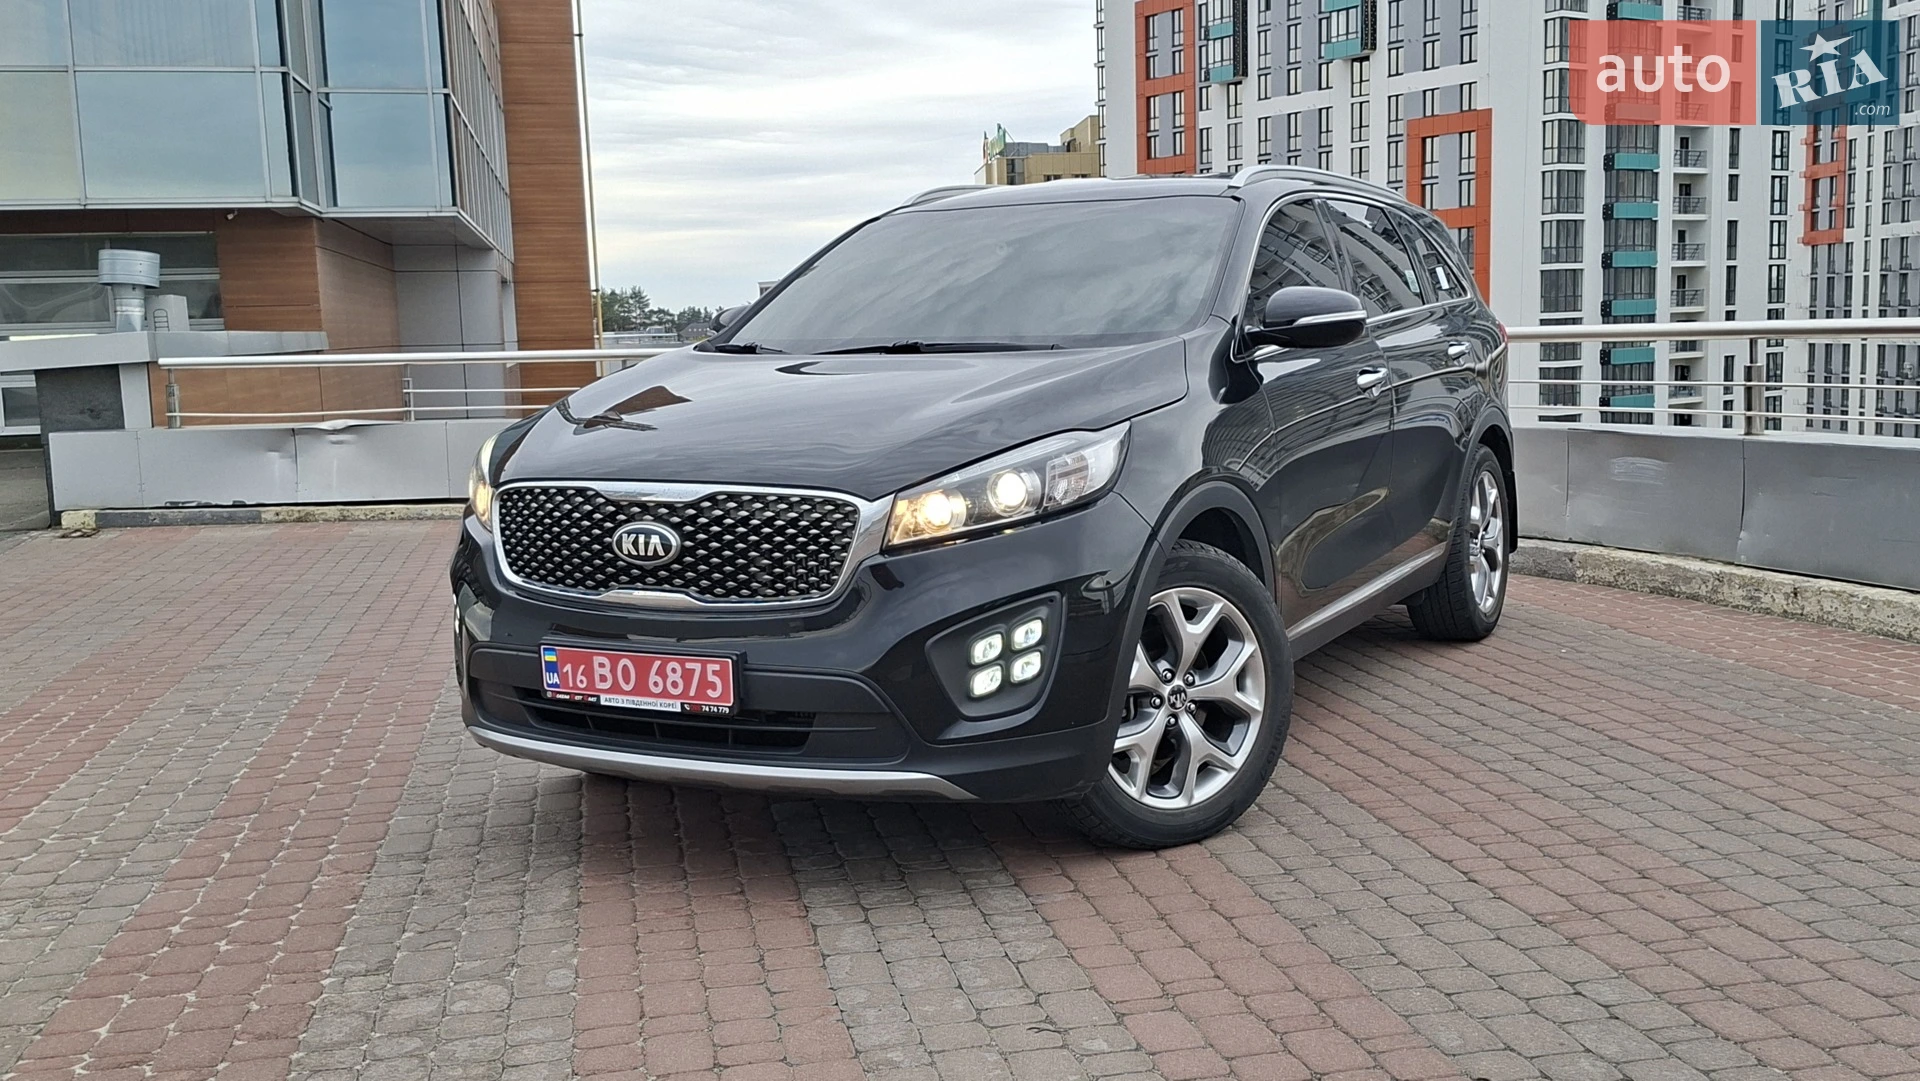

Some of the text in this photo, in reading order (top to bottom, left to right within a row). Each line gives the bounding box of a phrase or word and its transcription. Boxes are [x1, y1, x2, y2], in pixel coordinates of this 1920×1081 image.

[622, 533, 666, 556] KIA
[547, 672, 560, 685] UA
[562, 656, 723, 698] 16 BO 6875
[1169, 692, 1187, 703] KIA
